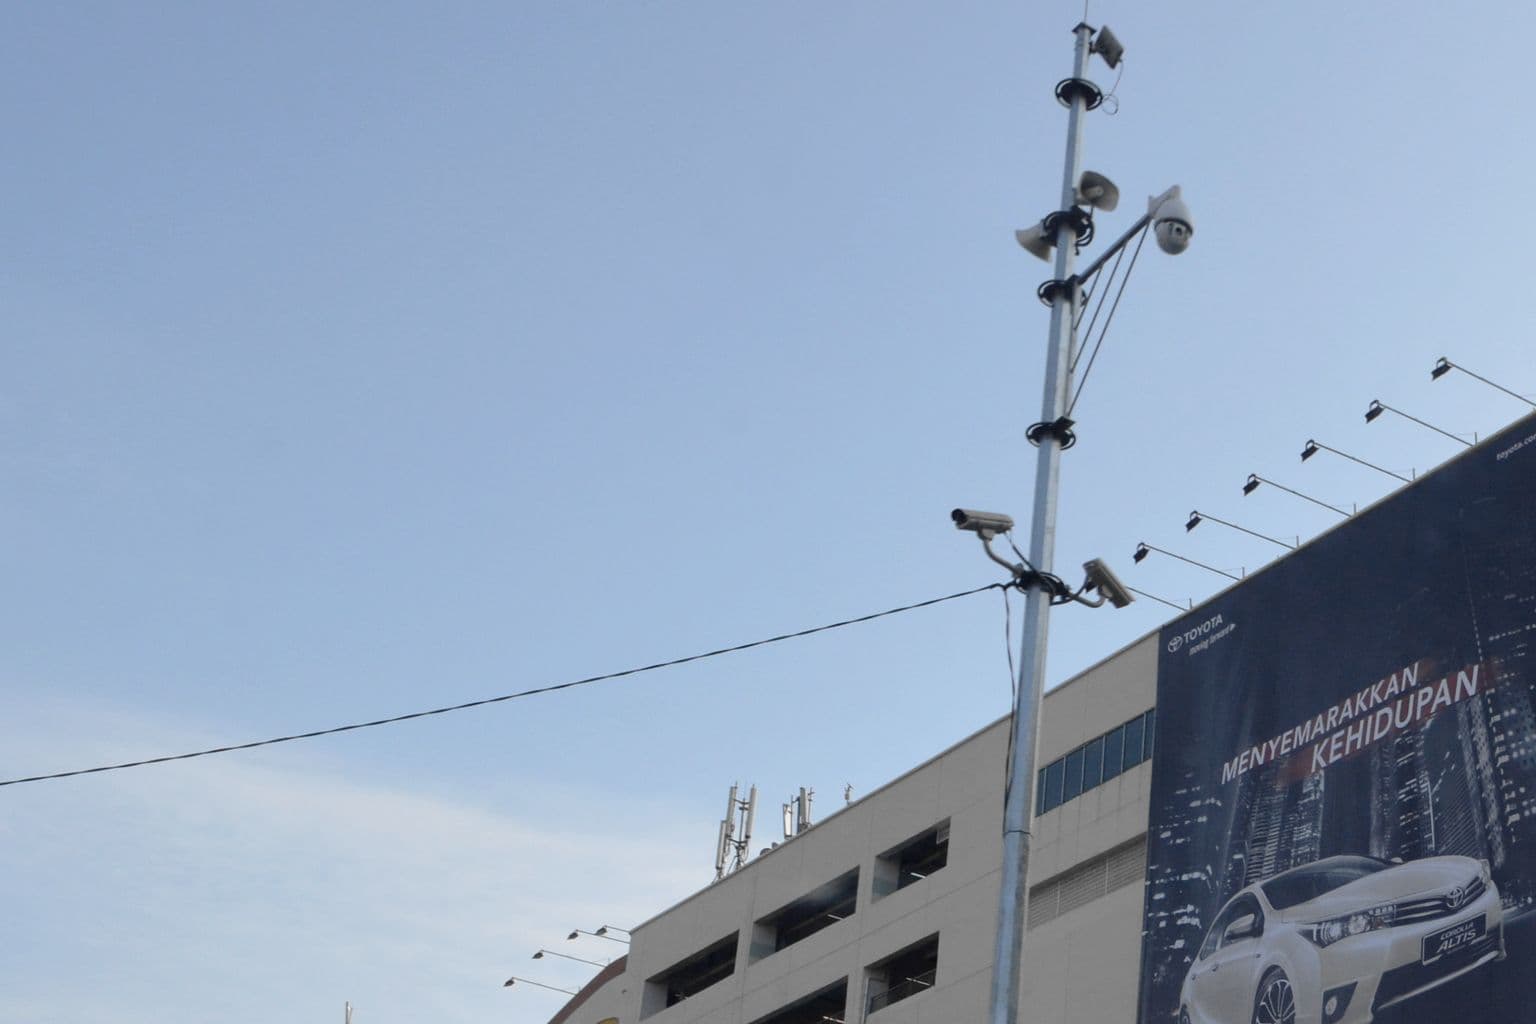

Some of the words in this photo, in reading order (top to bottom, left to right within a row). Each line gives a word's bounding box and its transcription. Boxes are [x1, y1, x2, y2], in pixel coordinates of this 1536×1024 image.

[1183, 613, 1223, 643] TOYOTA
[1221, 661, 1419, 785] MENYEMARAKKAN
[1311, 664, 1480, 773] KEHIDUPAN
[1436, 929, 1477, 953] ALTIS
[1440, 922, 1474, 941] COROLLA
